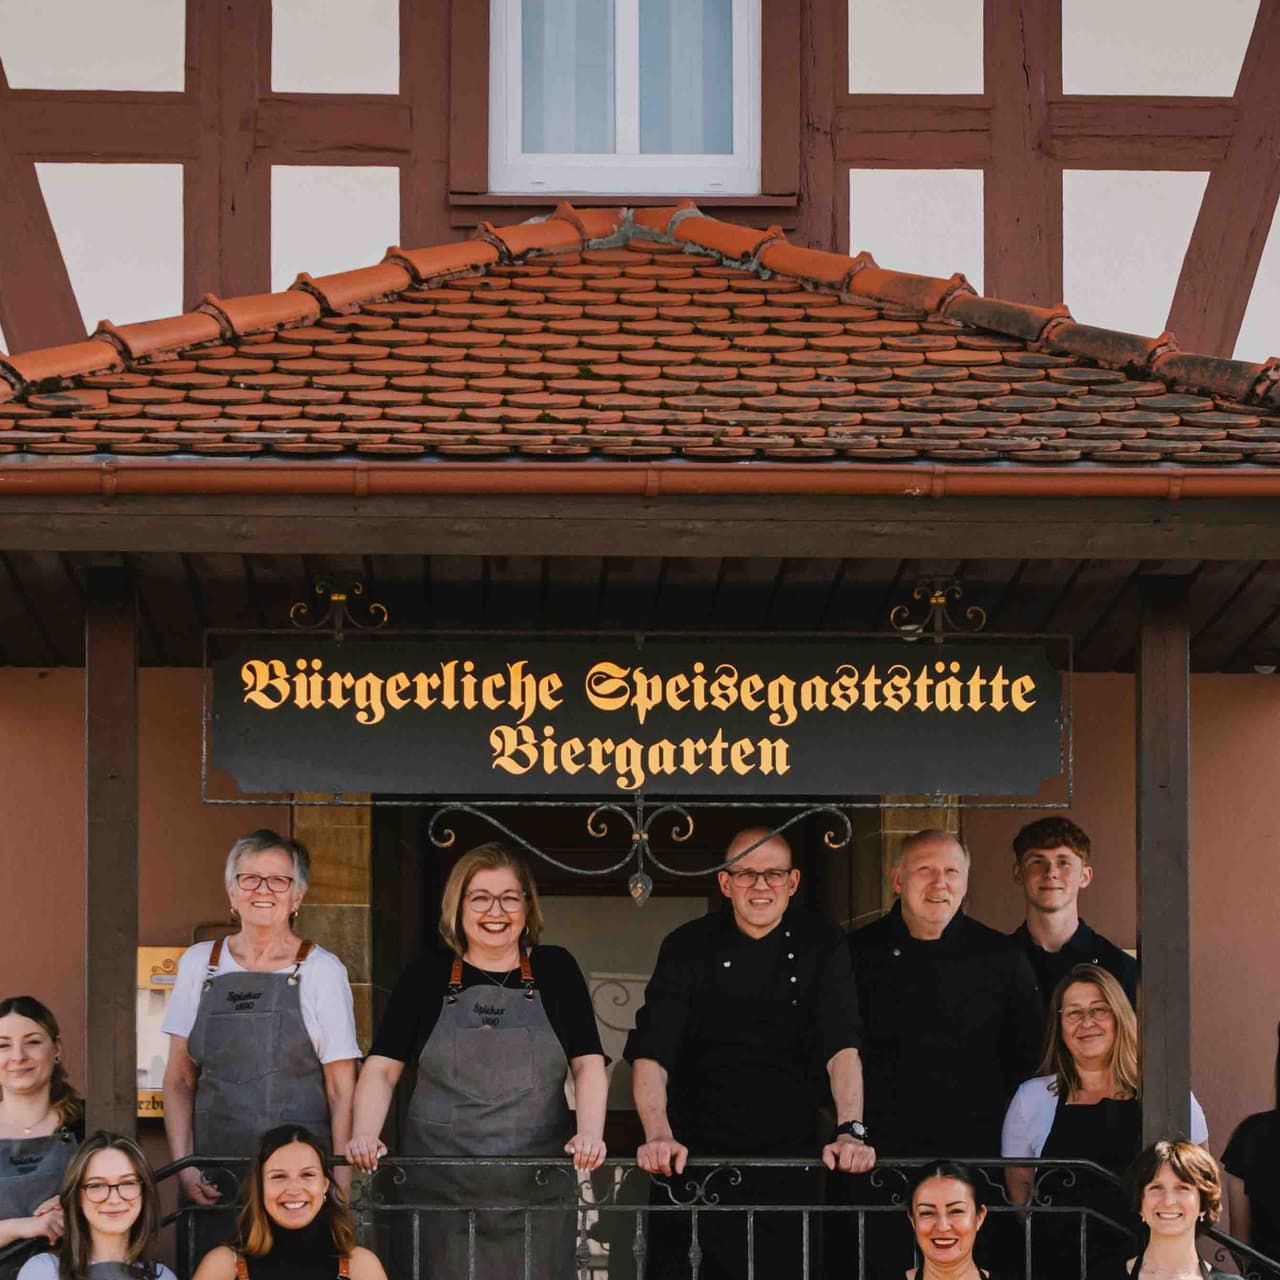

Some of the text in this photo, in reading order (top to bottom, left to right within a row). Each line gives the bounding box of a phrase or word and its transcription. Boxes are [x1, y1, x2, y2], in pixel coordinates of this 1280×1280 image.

[241, 658, 1037, 726] Bürgerliche Speisegaststätte
[489, 725, 791, 790] Biergarten
